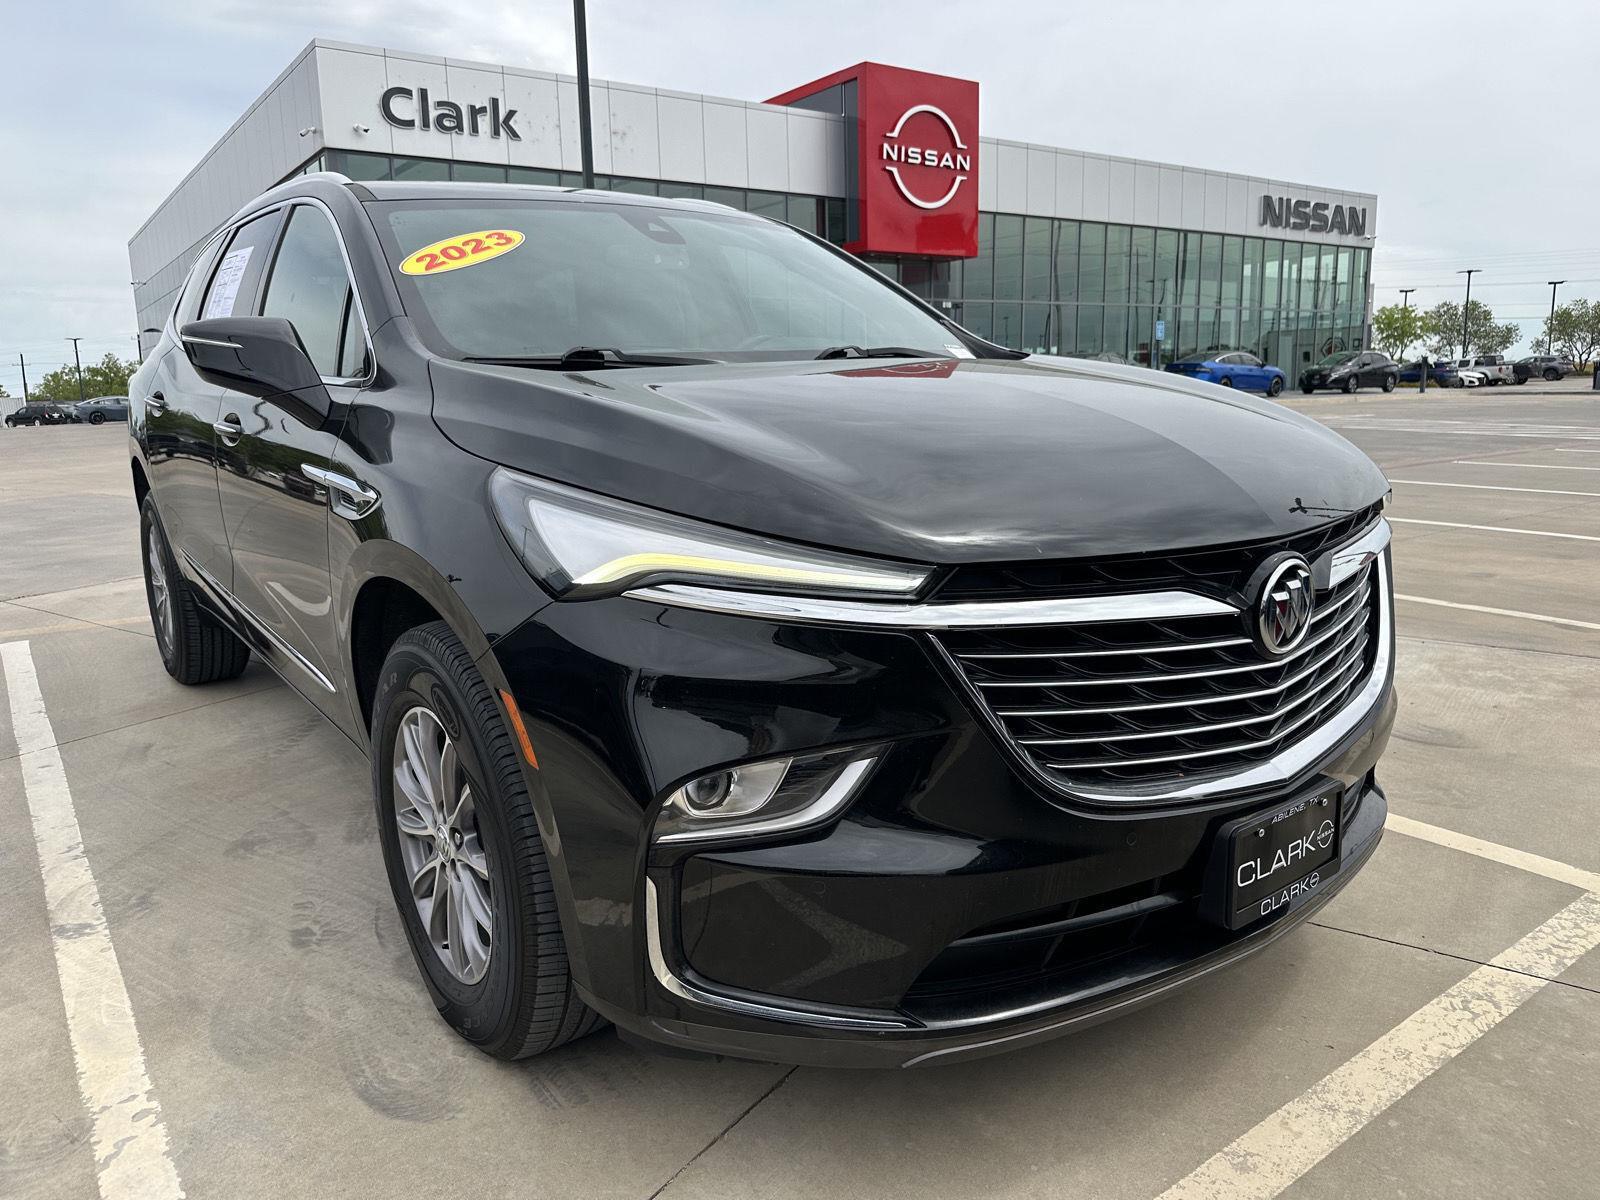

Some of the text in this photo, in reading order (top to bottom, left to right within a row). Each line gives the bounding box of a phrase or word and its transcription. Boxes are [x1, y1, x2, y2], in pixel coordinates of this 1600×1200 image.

[381, 86, 521, 141] Clark
[882, 142, 970, 171] NISSAN
[1259, 195, 1366, 236] NISSAN
[415, 232, 513, 271] 2023
[1309, 796, 1319, 806] TX
[1237, 829, 1316, 887] CLARK
[1260, 877, 1309, 915] CLARK
